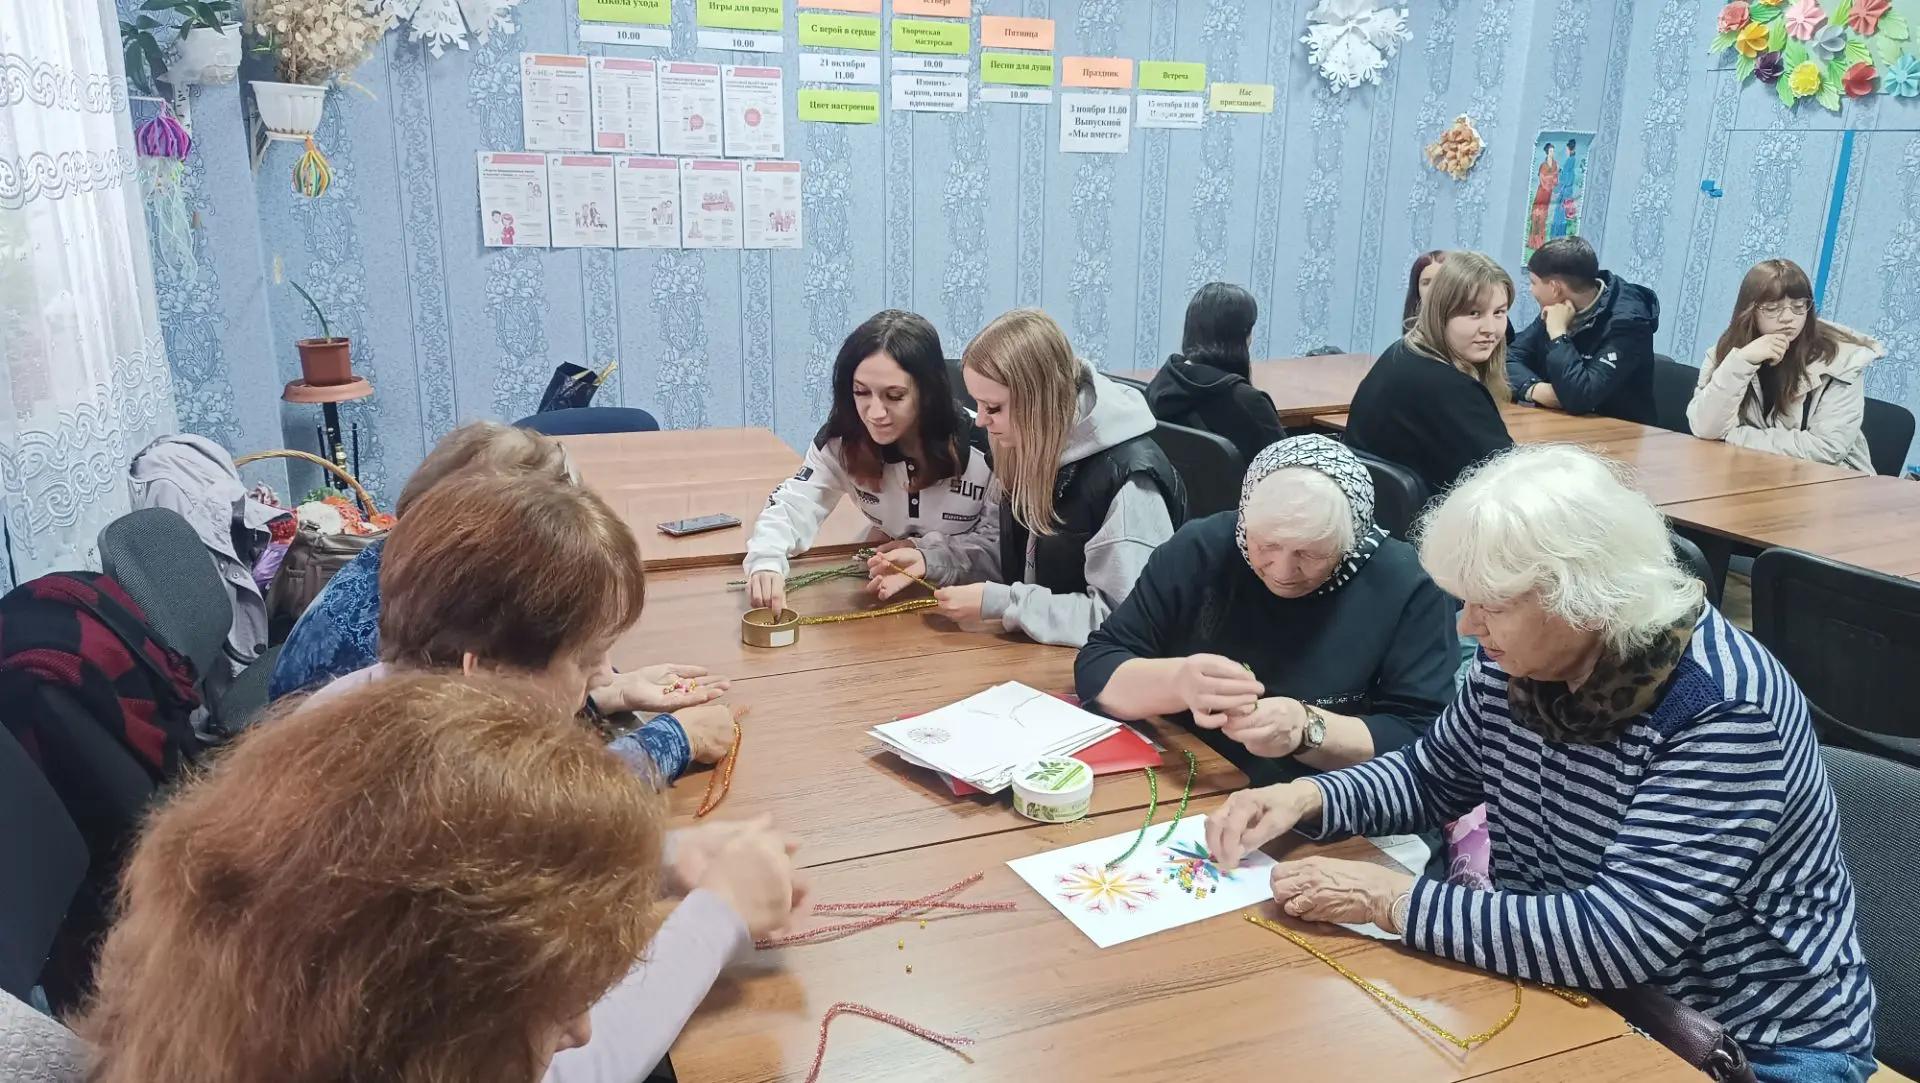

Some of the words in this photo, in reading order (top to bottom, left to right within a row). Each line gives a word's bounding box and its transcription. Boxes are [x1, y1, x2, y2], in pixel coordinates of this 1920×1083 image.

[633, 0, 659, 8] ухода
[709, 1, 732, 12] Игры
[734, 4, 750, 12] для
[751, 5, 779, 14] разума
[811, 24, 818, 33] С
[819, 25, 843, 35] верой
[851, 28, 877, 37] сердце
[902, 26, 941, 36] Творческая
[1004, 28, 1039, 39] Пятница
[617, 31, 641, 41] 10.00
[732, 39, 755, 48] 10.00
[915, 39, 953, 48] мастерская
[820, 58, 829, 67] 21
[831, 59, 866, 69] октября
[923, 60, 943, 68] 10.00
[990, 60, 1014, 70] Песни
[1016, 63, 1030, 71] для
[1031, 64, 1051, 72] души
[835, 71, 855, 80] 11.00
[1082, 68, 1119, 79] Праздник
[1162, 71, 1189, 80] Встреча
[1010, 91, 1029, 99] 10.00
[809, 101, 829, 111] Цвет
[831, 102, 875, 112] настроения
[1076, 104, 1106, 115] ноября
[1108, 105, 1127, 115] 11.00
[1074, 116, 1121, 129] Выпускной
